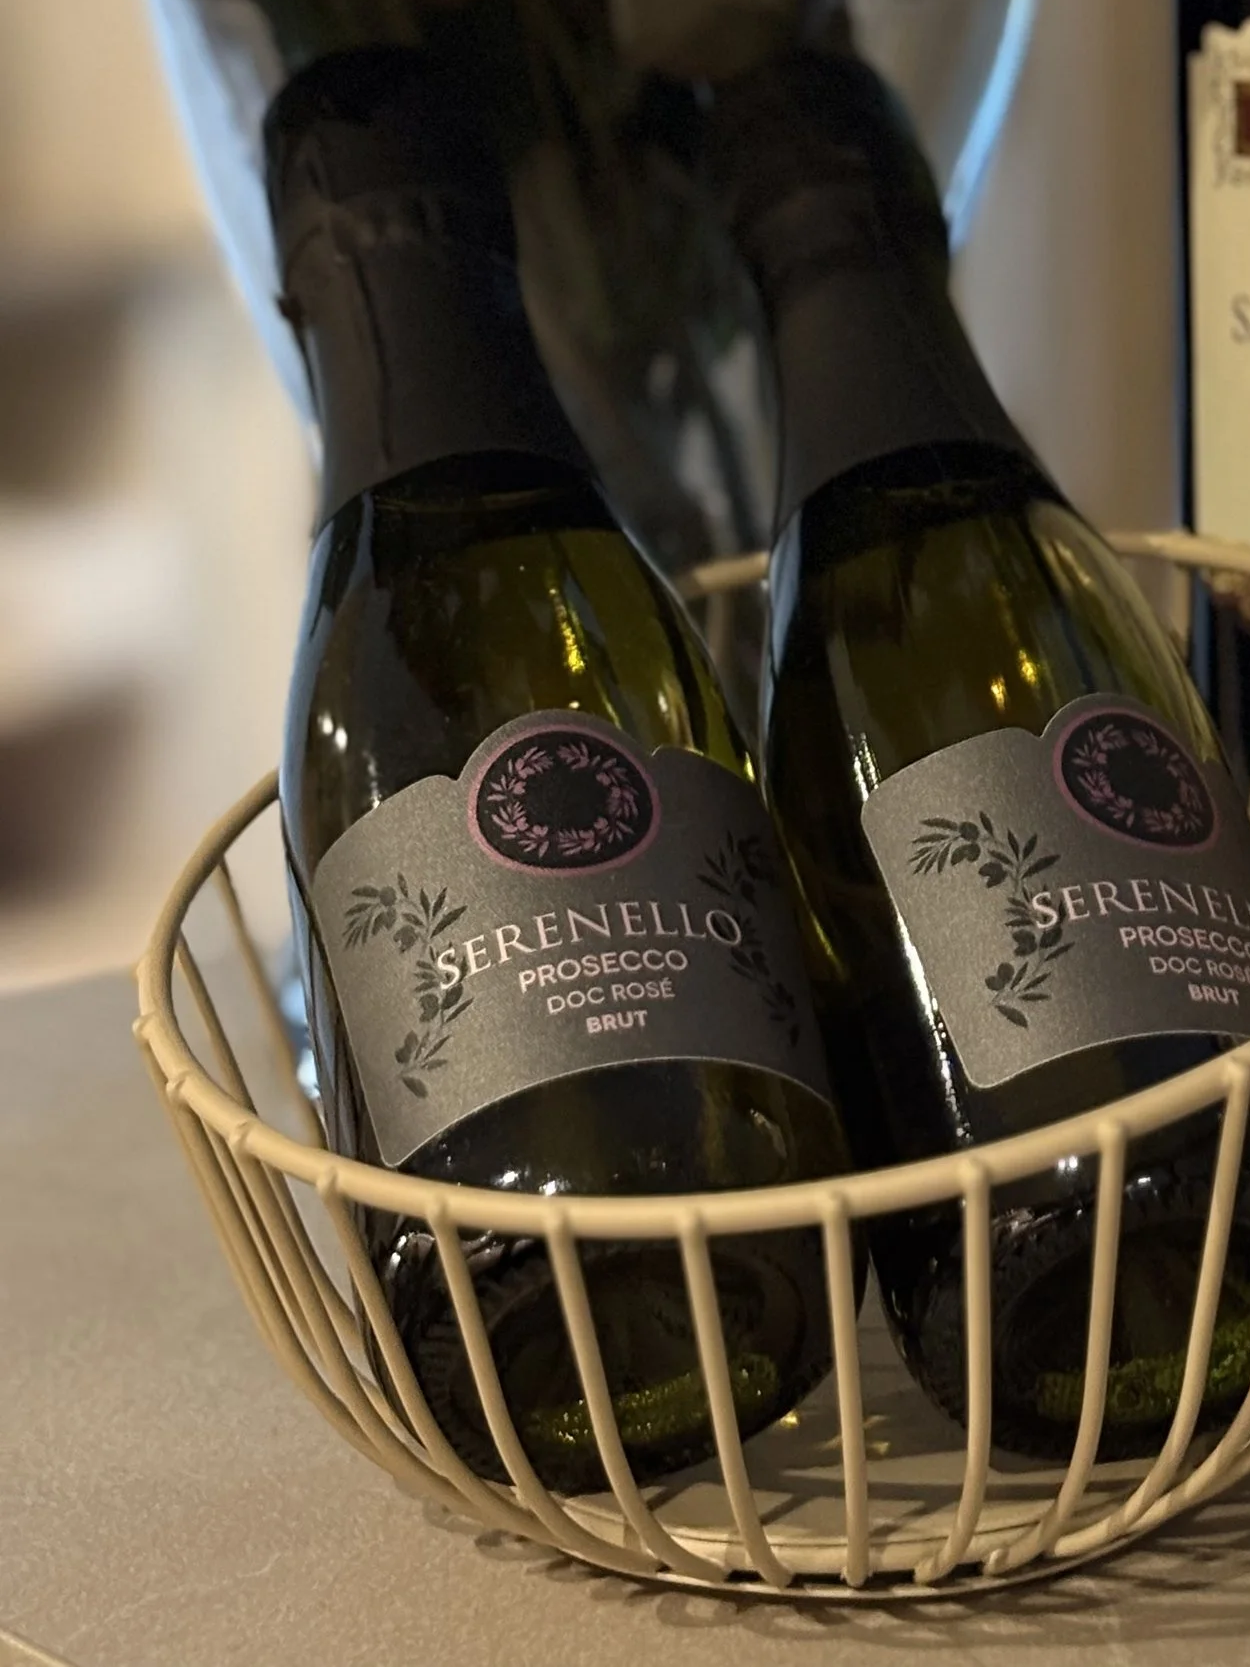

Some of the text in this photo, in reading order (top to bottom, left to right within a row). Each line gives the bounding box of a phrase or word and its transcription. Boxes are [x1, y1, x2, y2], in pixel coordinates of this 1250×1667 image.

[436, 901, 742, 990] SERENELLO
[518, 949, 689, 994] PROSECCO
[1149, 956, 1202, 975] DOC
[546, 976, 676, 1015] DOC ROSÉ
[1187, 982, 1239, 1006] BRUT
[585, 1009, 648, 1034] BRUT
